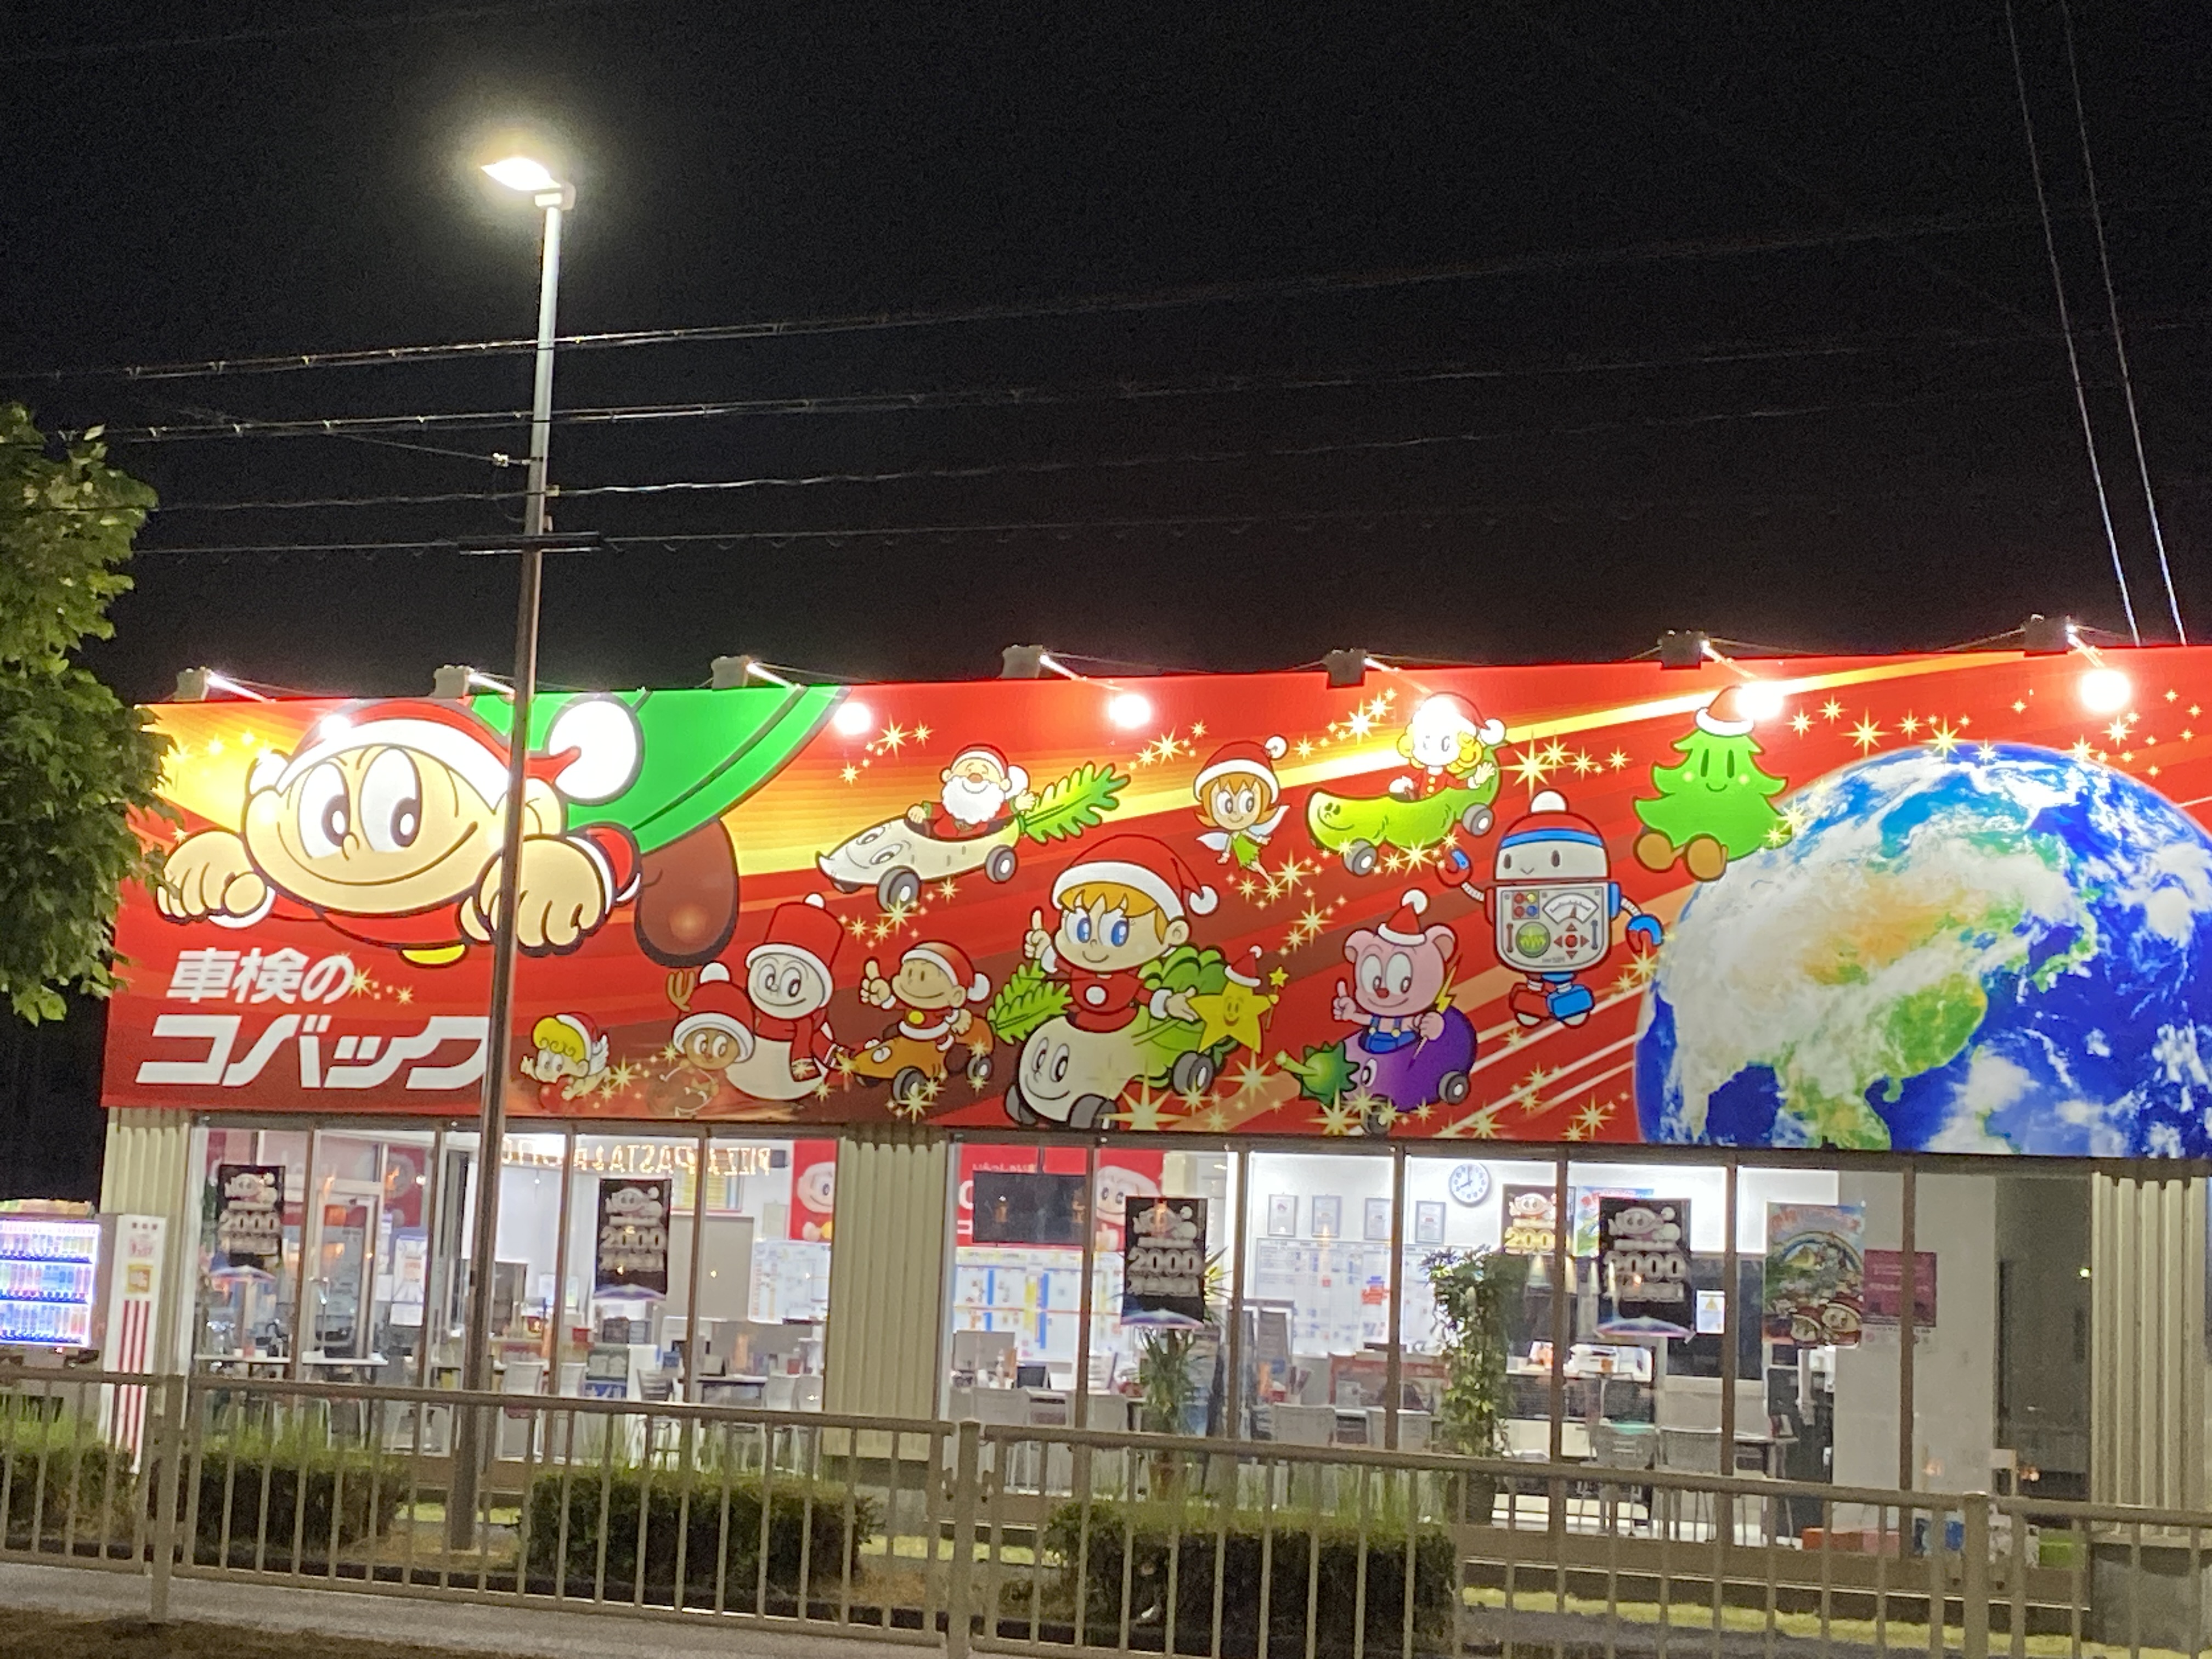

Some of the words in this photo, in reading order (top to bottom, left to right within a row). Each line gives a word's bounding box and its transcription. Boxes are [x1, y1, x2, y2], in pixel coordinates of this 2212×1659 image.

[166, 947, 356, 1005] 車検の
[135, 1014, 490, 1090] コバック
[1127, 1246, 1205, 1276] 2000
[1504, 1226, 1572, 1253] 200
